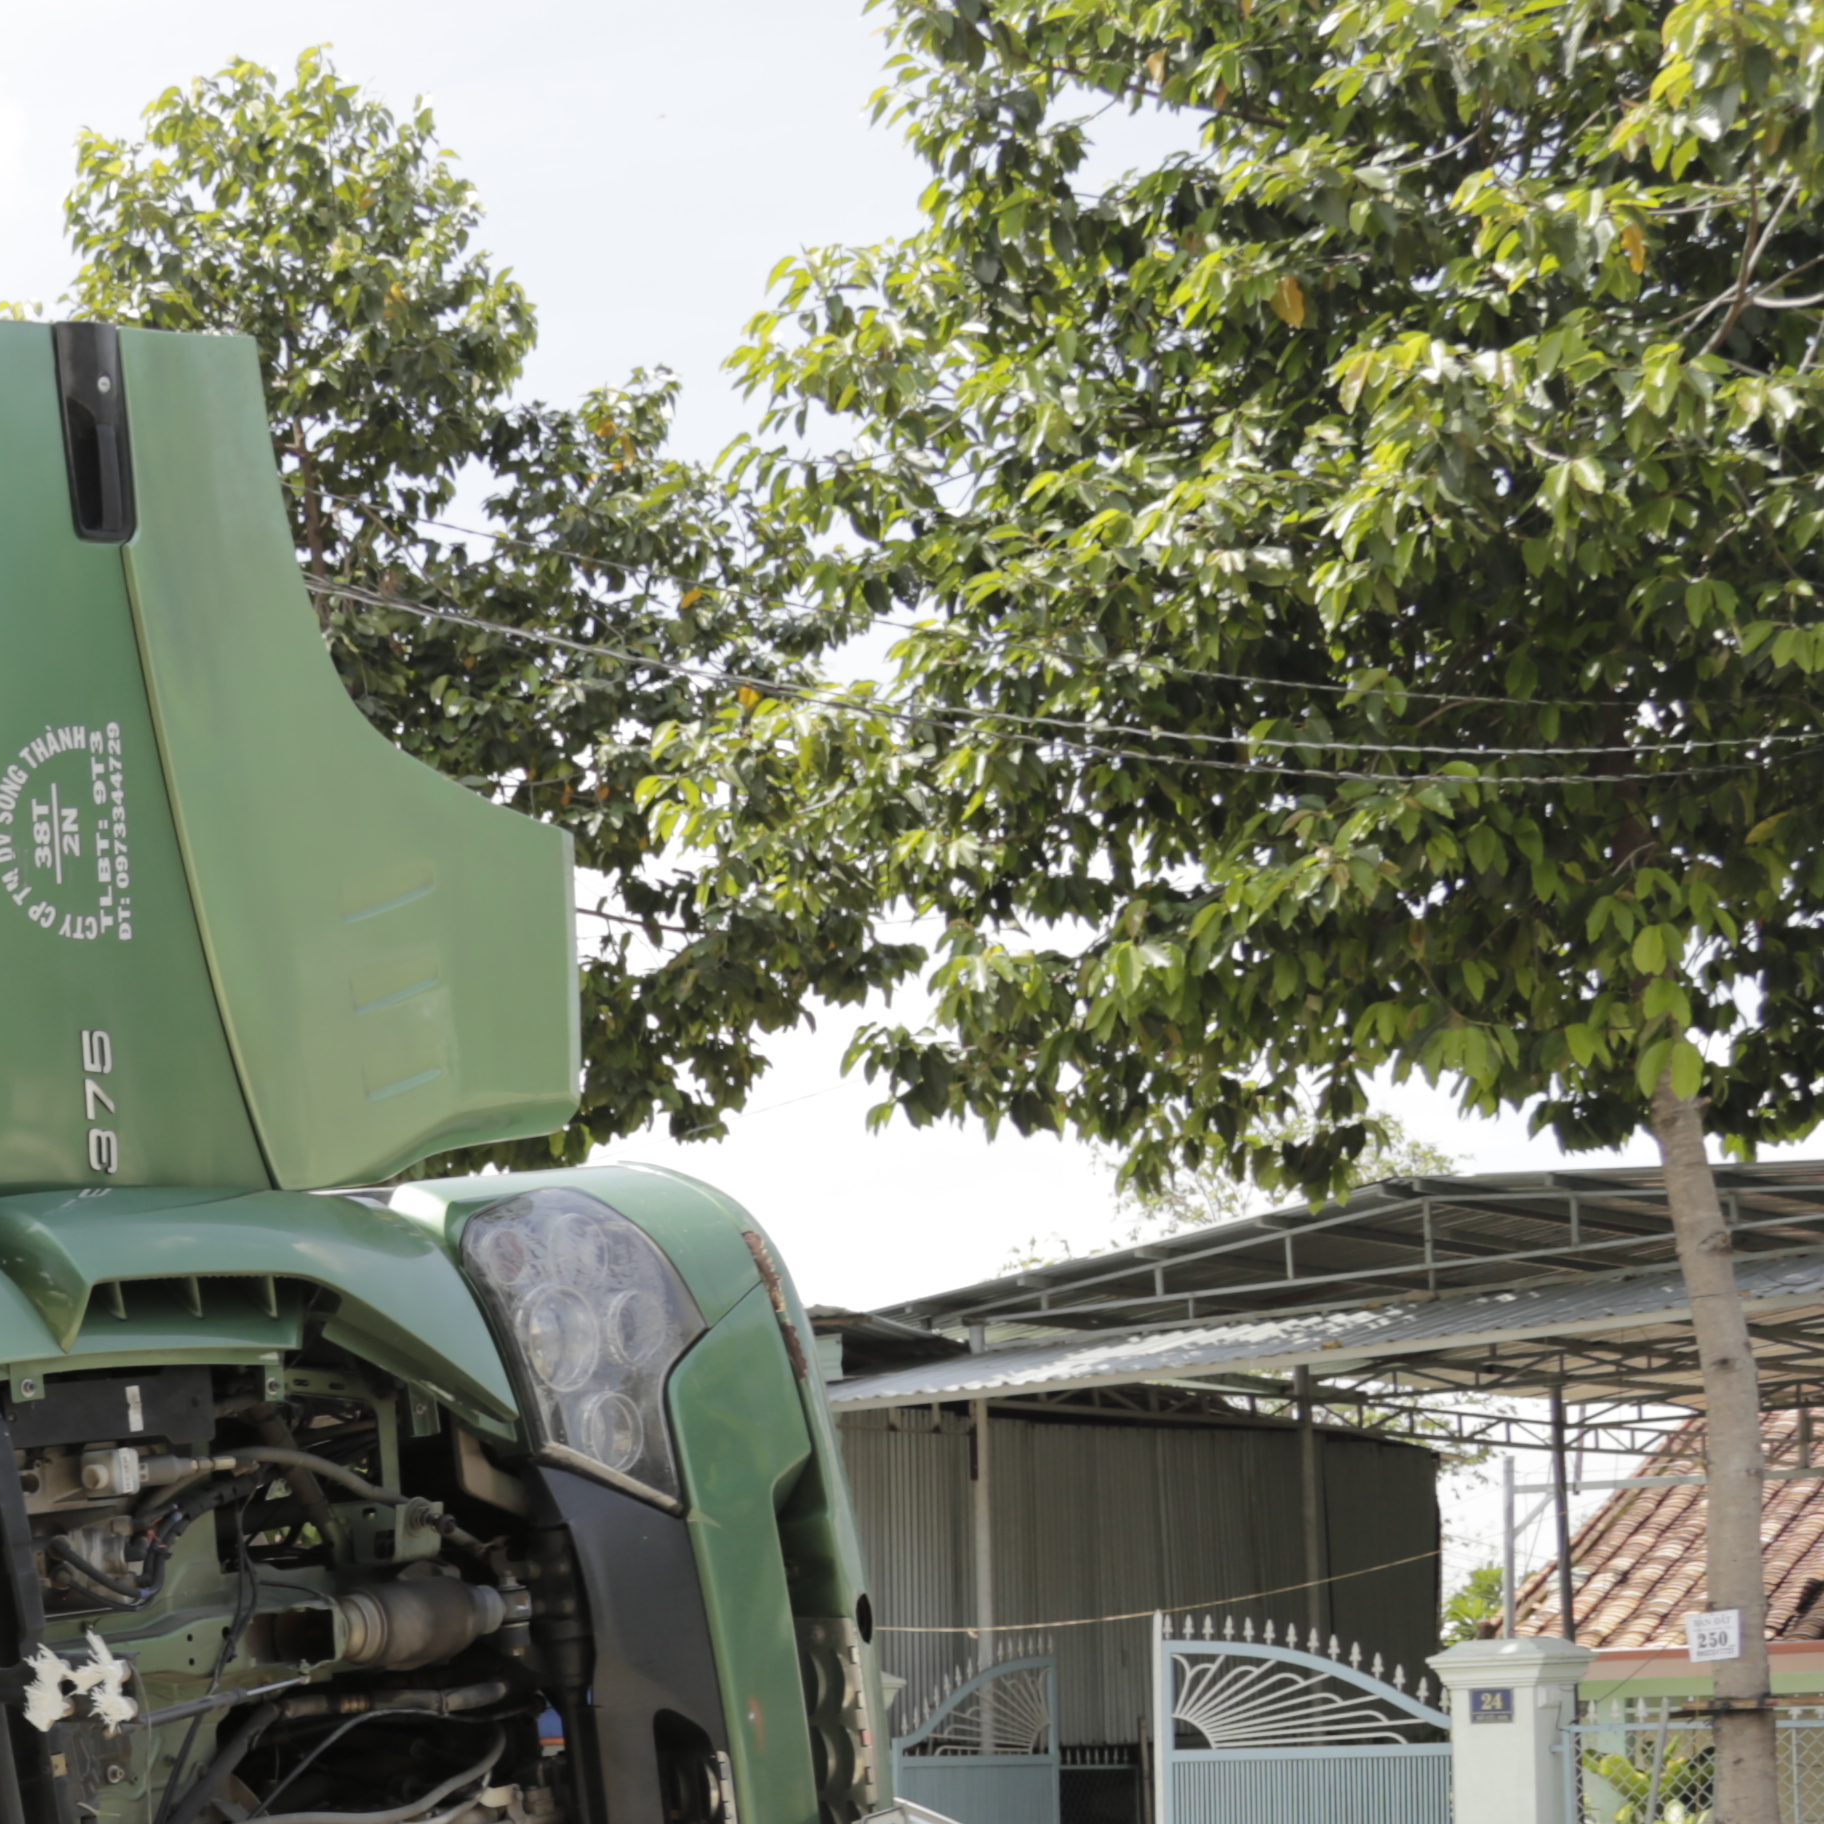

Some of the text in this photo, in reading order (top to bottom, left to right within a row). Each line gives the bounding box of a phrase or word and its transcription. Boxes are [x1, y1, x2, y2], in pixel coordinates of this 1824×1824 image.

[18, 724, 86, 769] THÀNH
[106, 721, 129, 889] 0973344729
[31, 798, 52, 868] 38T
[60, 808, 81, 857] 2N
[89, 730, 114, 934] TLBT: 9T3
[2, 867, 33, 906] TM
[28, 901, 56, 928] CP
[58, 913, 98, 940] CTY
[82, 1030, 118, 1175] 375
[1697, 1631, 1728, 1648] 250
[1481, 1692, 1503, 1710] 24
